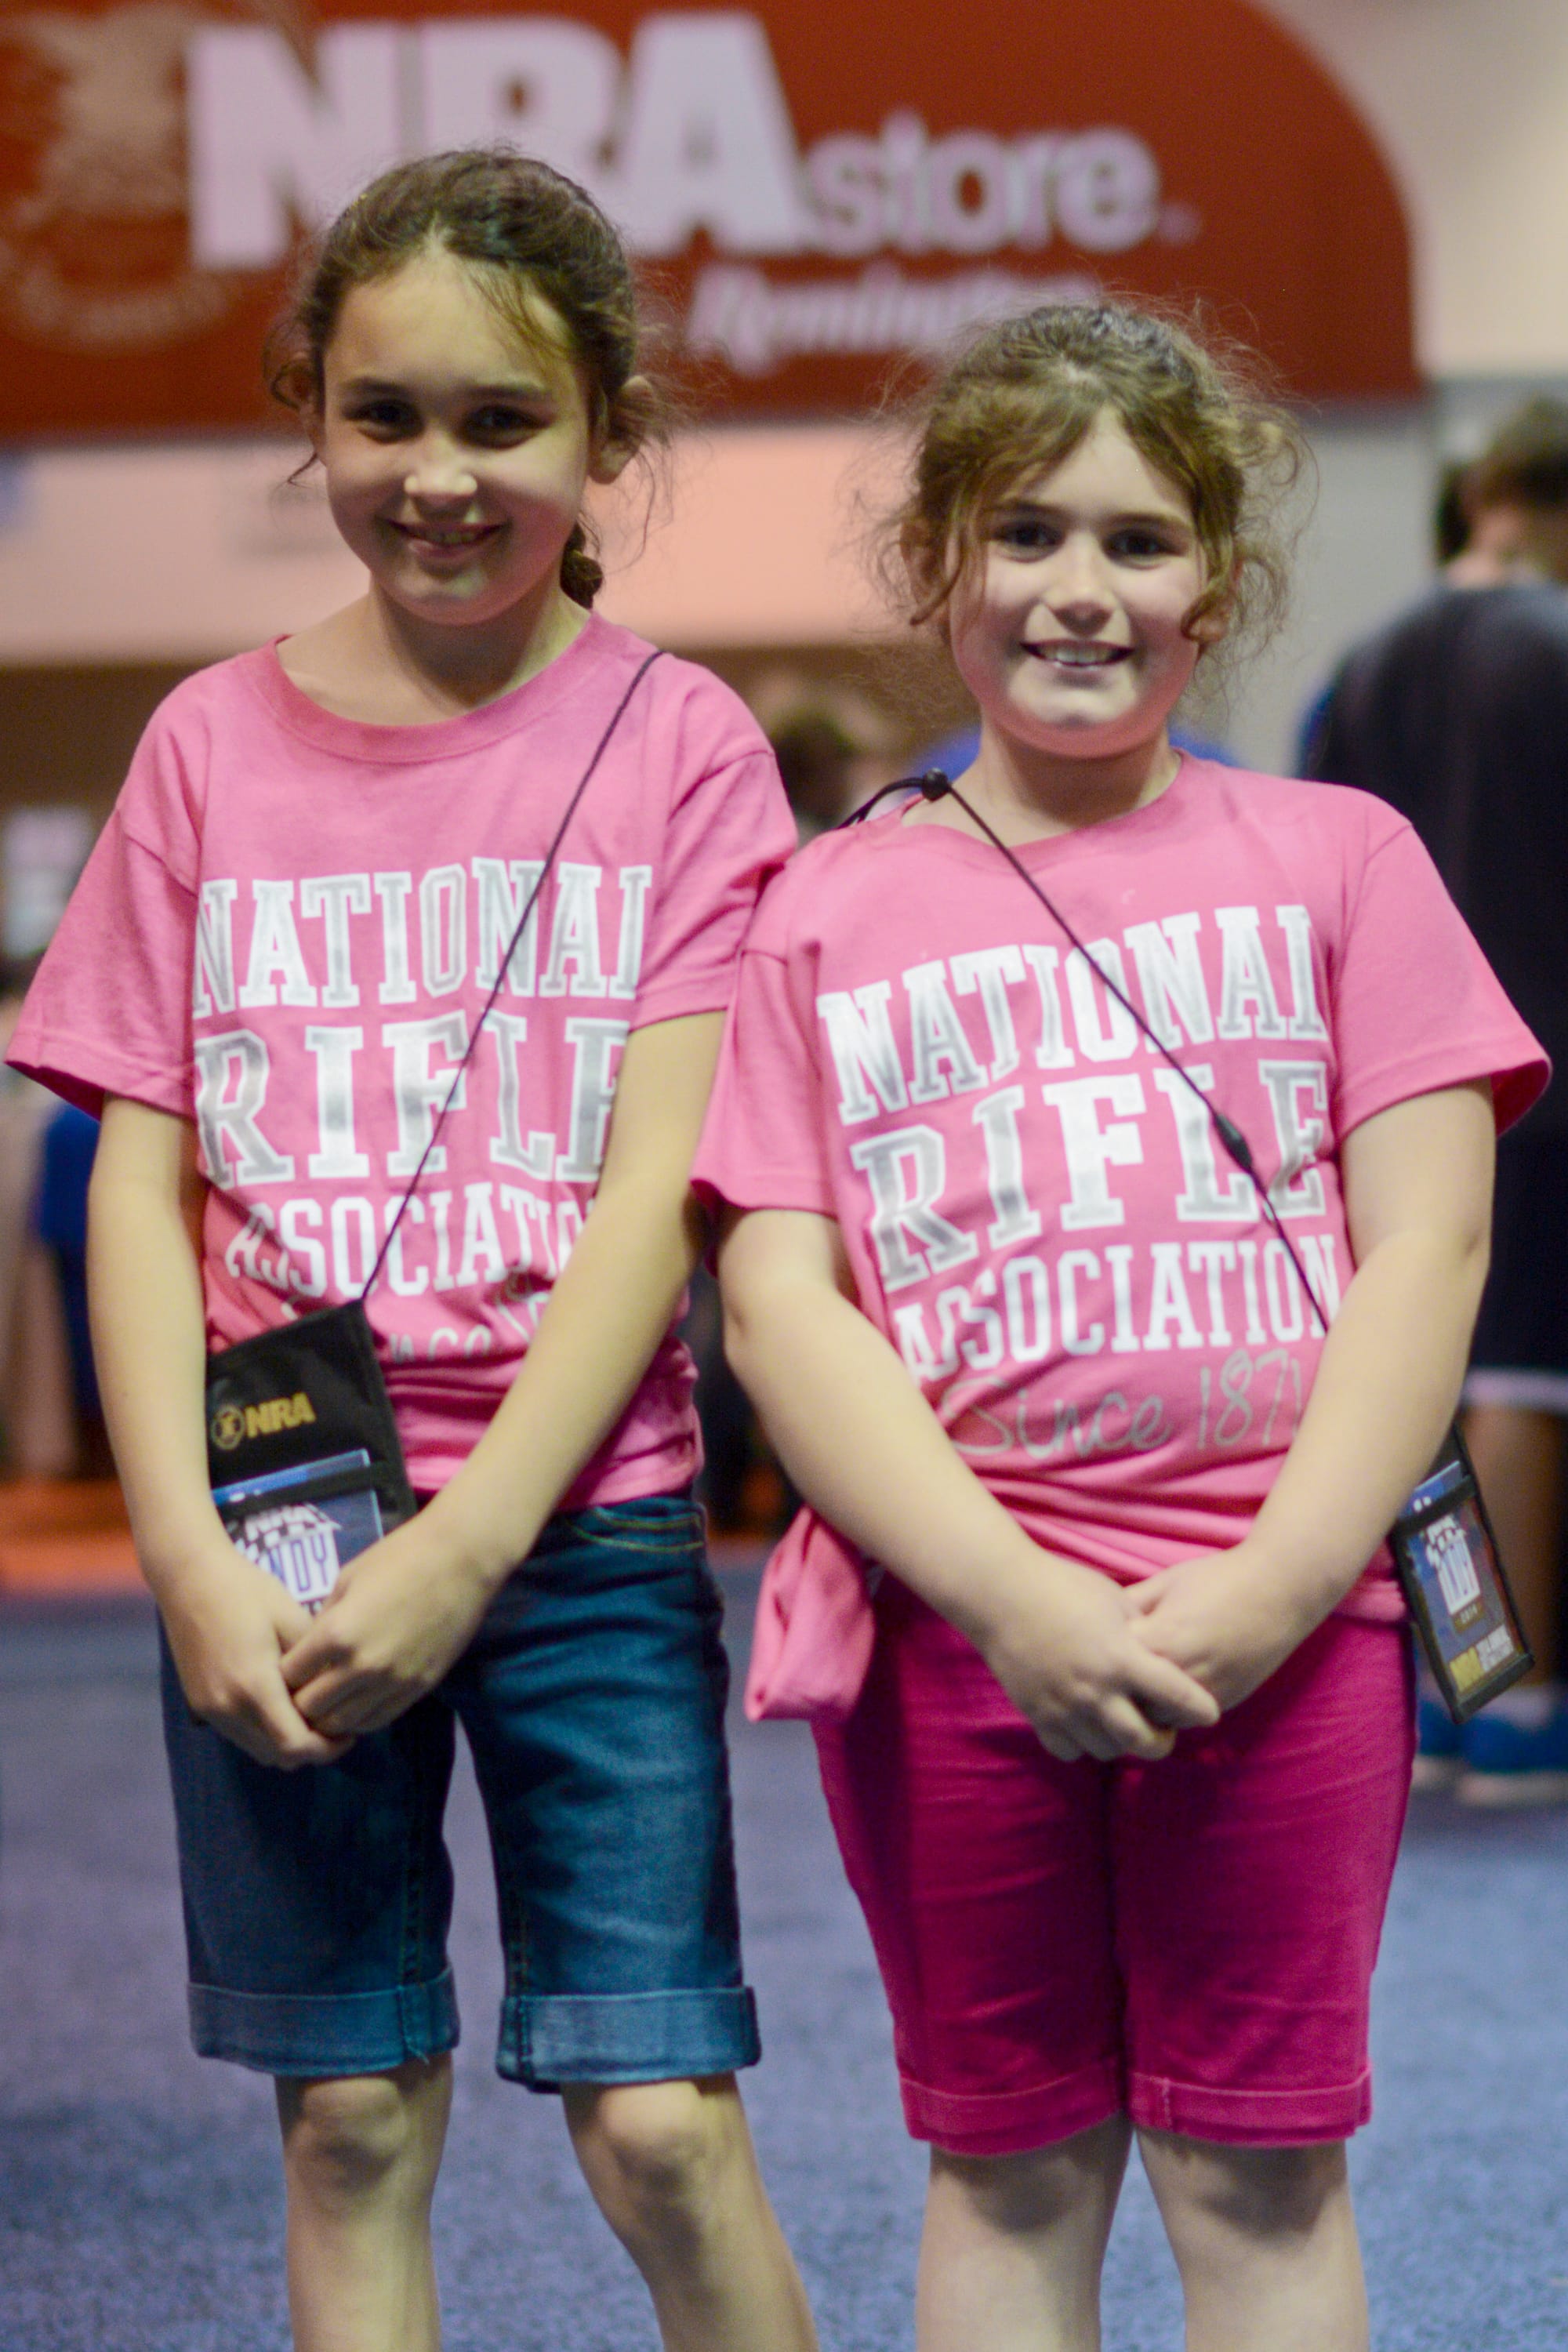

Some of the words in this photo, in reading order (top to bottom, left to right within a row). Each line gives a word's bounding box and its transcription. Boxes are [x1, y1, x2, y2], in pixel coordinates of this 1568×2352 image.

[850, 1058, 1328, 1294] RIFLE
[225, 1182, 596, 1298] ASSOCIATIO
[894, 1233, 1339, 1386] ASSOCIATION
[246, 1392, 317, 1439] NRA
[942, 1376, 1178, 1460] Since
[1197, 1348, 1303, 1450] 1871
